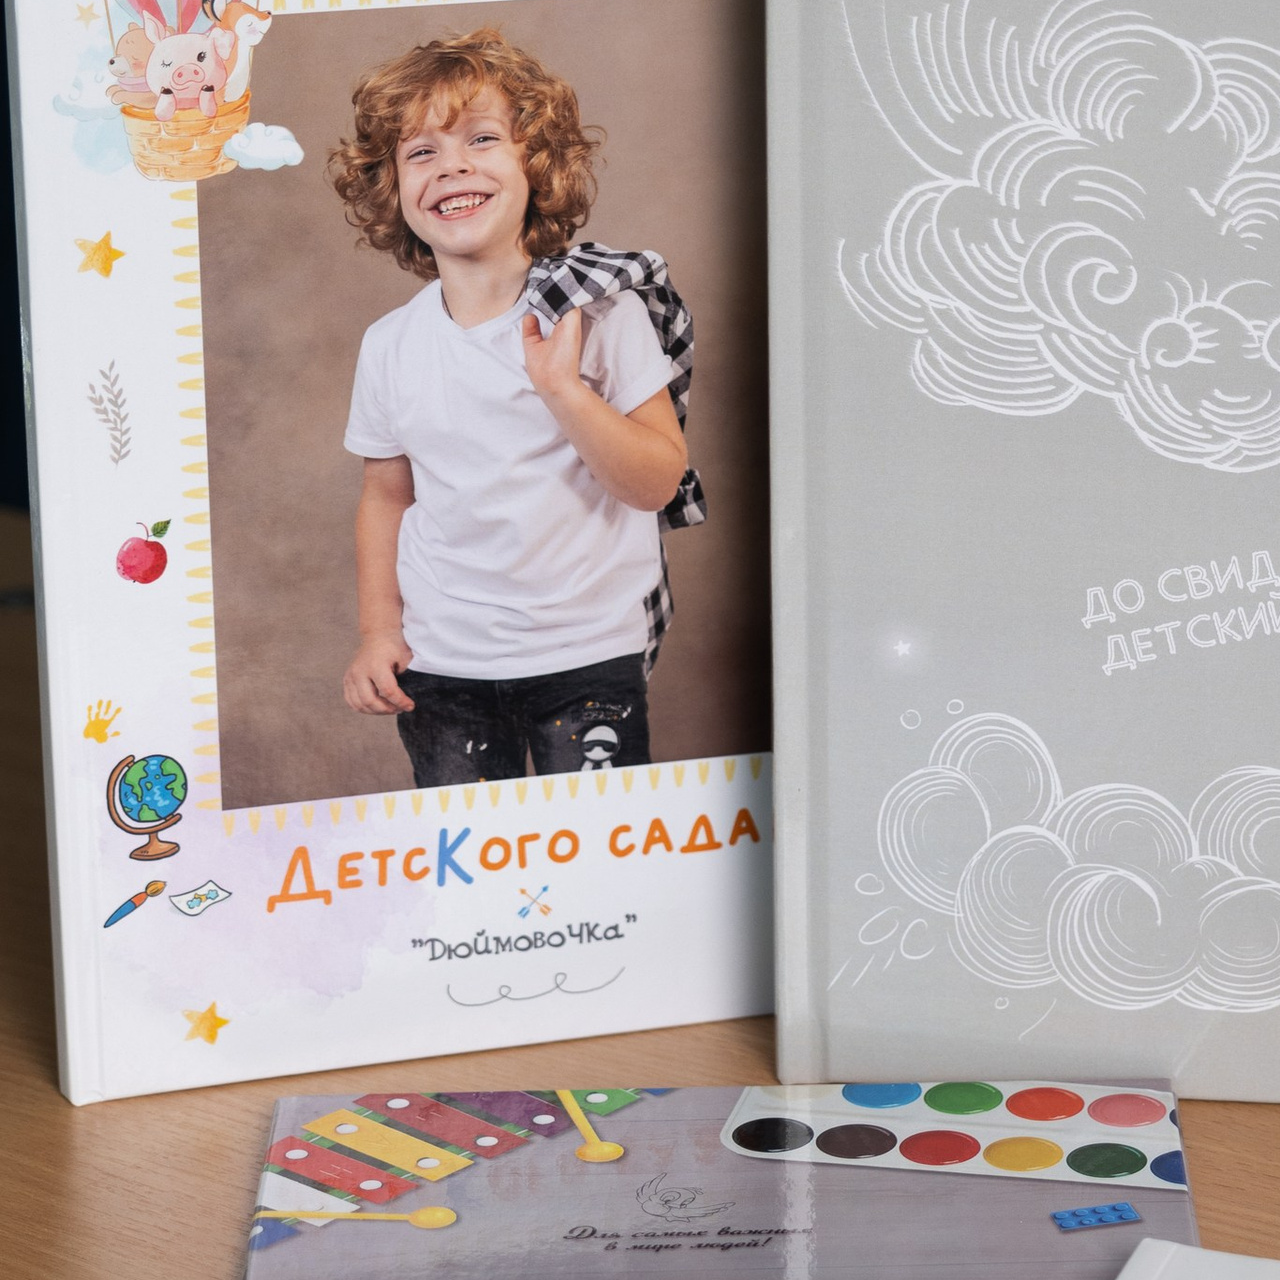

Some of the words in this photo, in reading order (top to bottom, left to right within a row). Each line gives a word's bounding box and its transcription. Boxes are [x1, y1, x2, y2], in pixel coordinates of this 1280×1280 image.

[1081, 579, 1146, 629] ДО
[563, 1224, 621, 1240] Для
[631, 1228, 708, 1239] самых
[625, 1241, 683, 1253] мире
[690, 1235, 773, 1251] людей!
